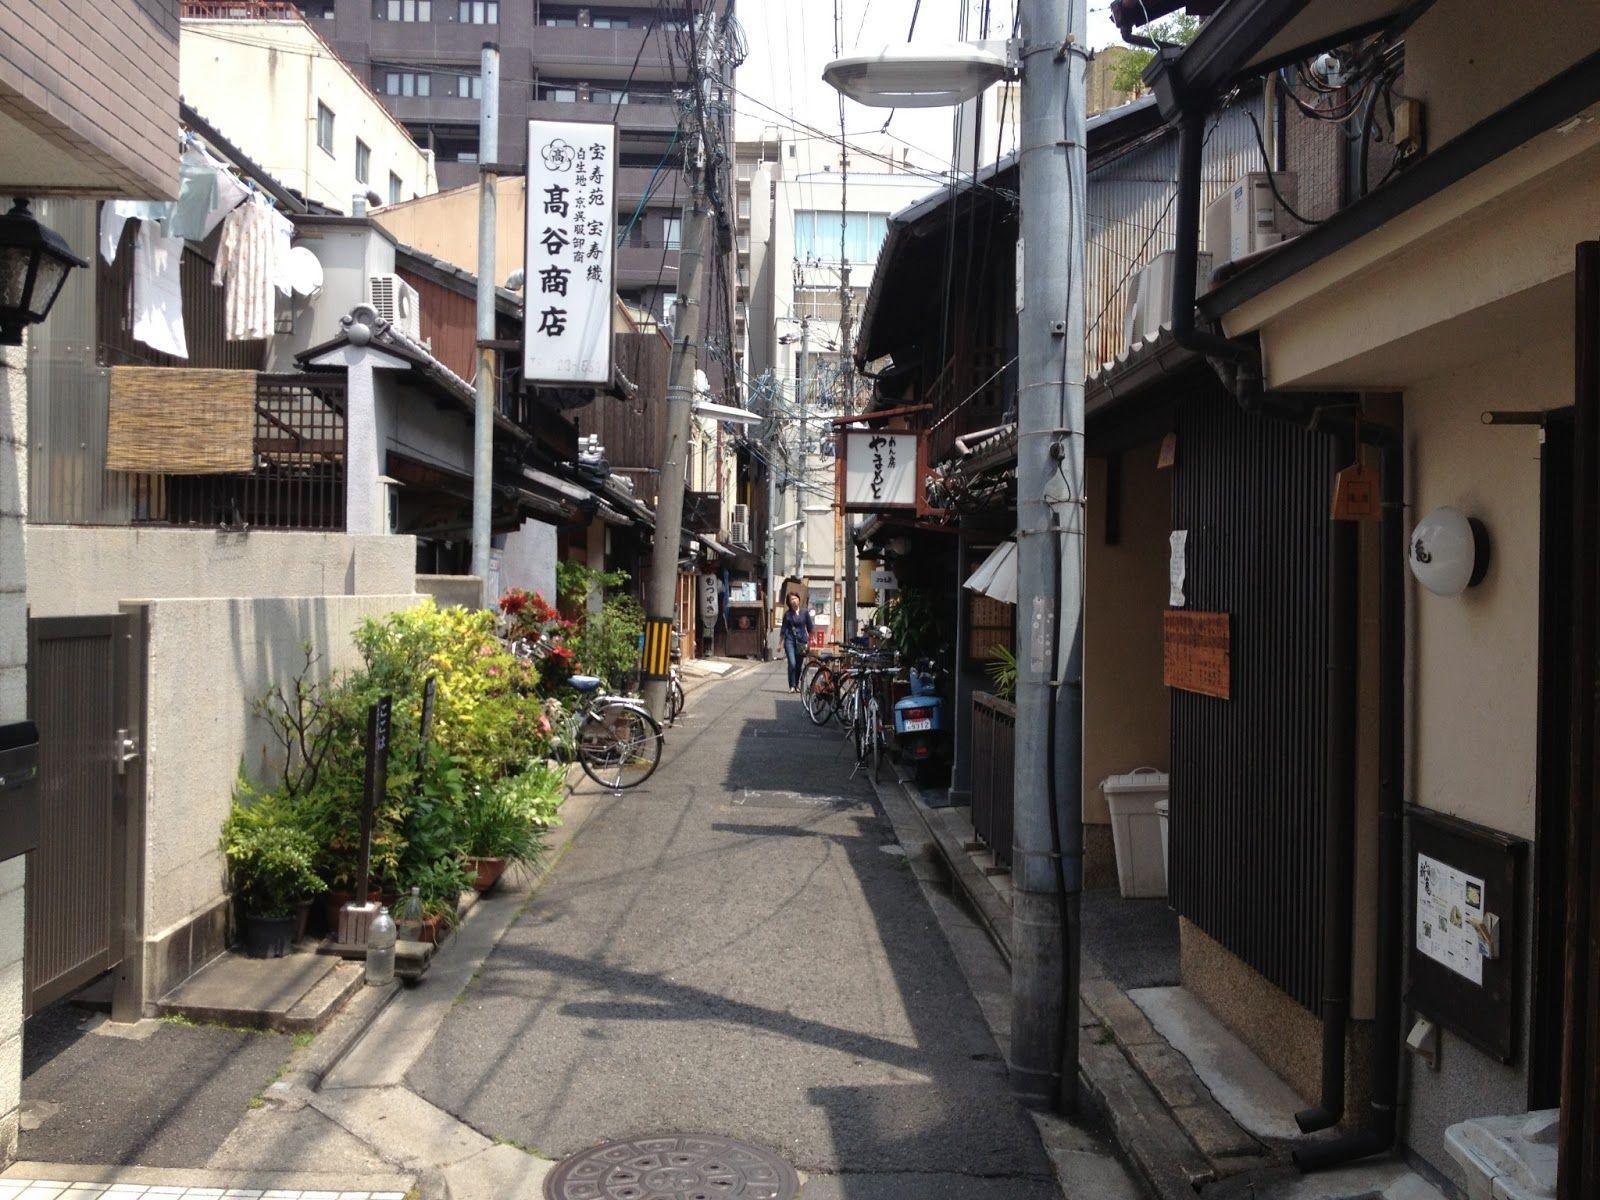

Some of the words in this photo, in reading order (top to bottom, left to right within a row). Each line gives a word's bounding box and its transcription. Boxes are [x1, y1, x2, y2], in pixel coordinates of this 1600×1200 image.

[588, 142, 606, 206] 宝寿苑
[586, 219, 604, 283] 宝寿織
